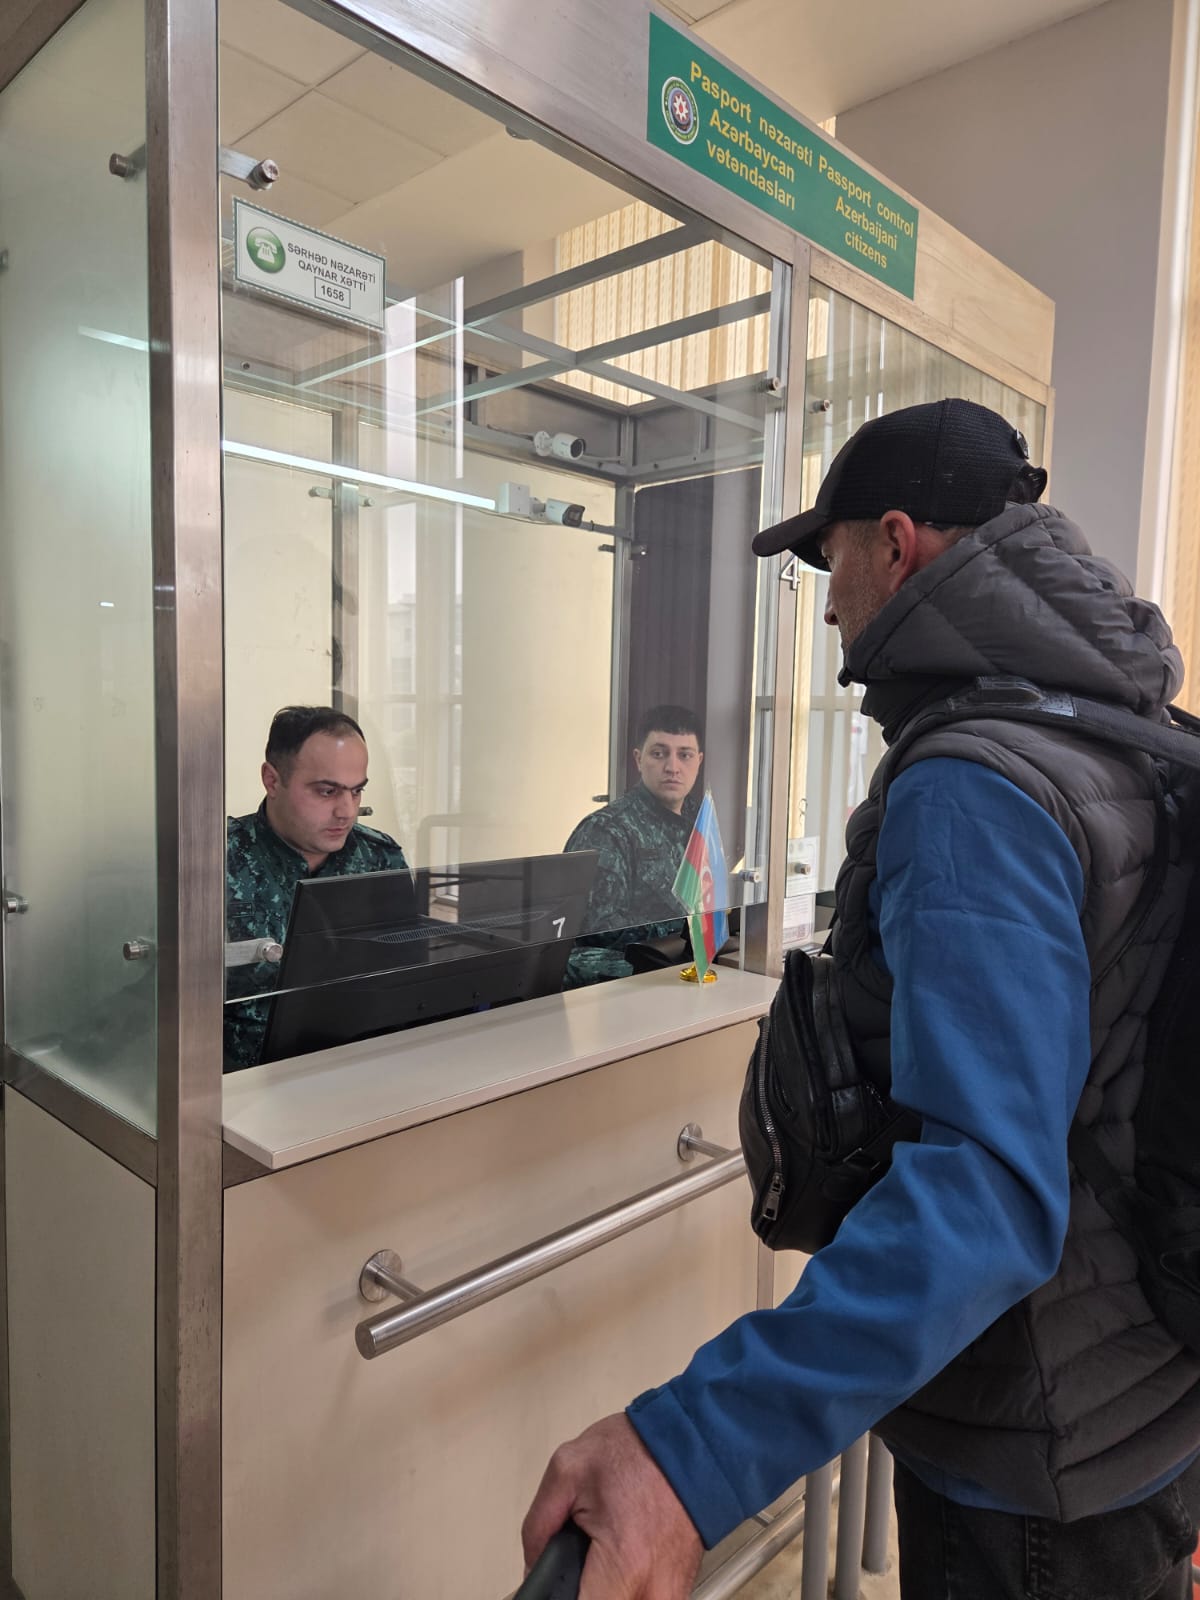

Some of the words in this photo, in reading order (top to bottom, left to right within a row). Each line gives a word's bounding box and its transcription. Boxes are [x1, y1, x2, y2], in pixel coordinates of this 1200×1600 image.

[690, 61, 752, 123] Pasport
[759, 116, 813, 167] nəzarəti
[709, 109, 795, 182] Azərbaycan
[706, 139, 795, 210] vətəndasları
[818, 155, 872, 208] Passport
[876, 201, 914, 238] control
[835, 196, 897, 251] Azerbaijani
[288, 242, 328, 265] SƏRHƏD
[330, 259, 376, 284] NƏZARƏTİ
[845, 231, 887, 269] citizens
[298, 260, 337, 281] QAYNAR
[340, 275, 366, 291] XƏTTİ
[321, 285, 345, 301] 1658
[780, 555, 800, 590] 4
[552, 916, 566, 938] 7
